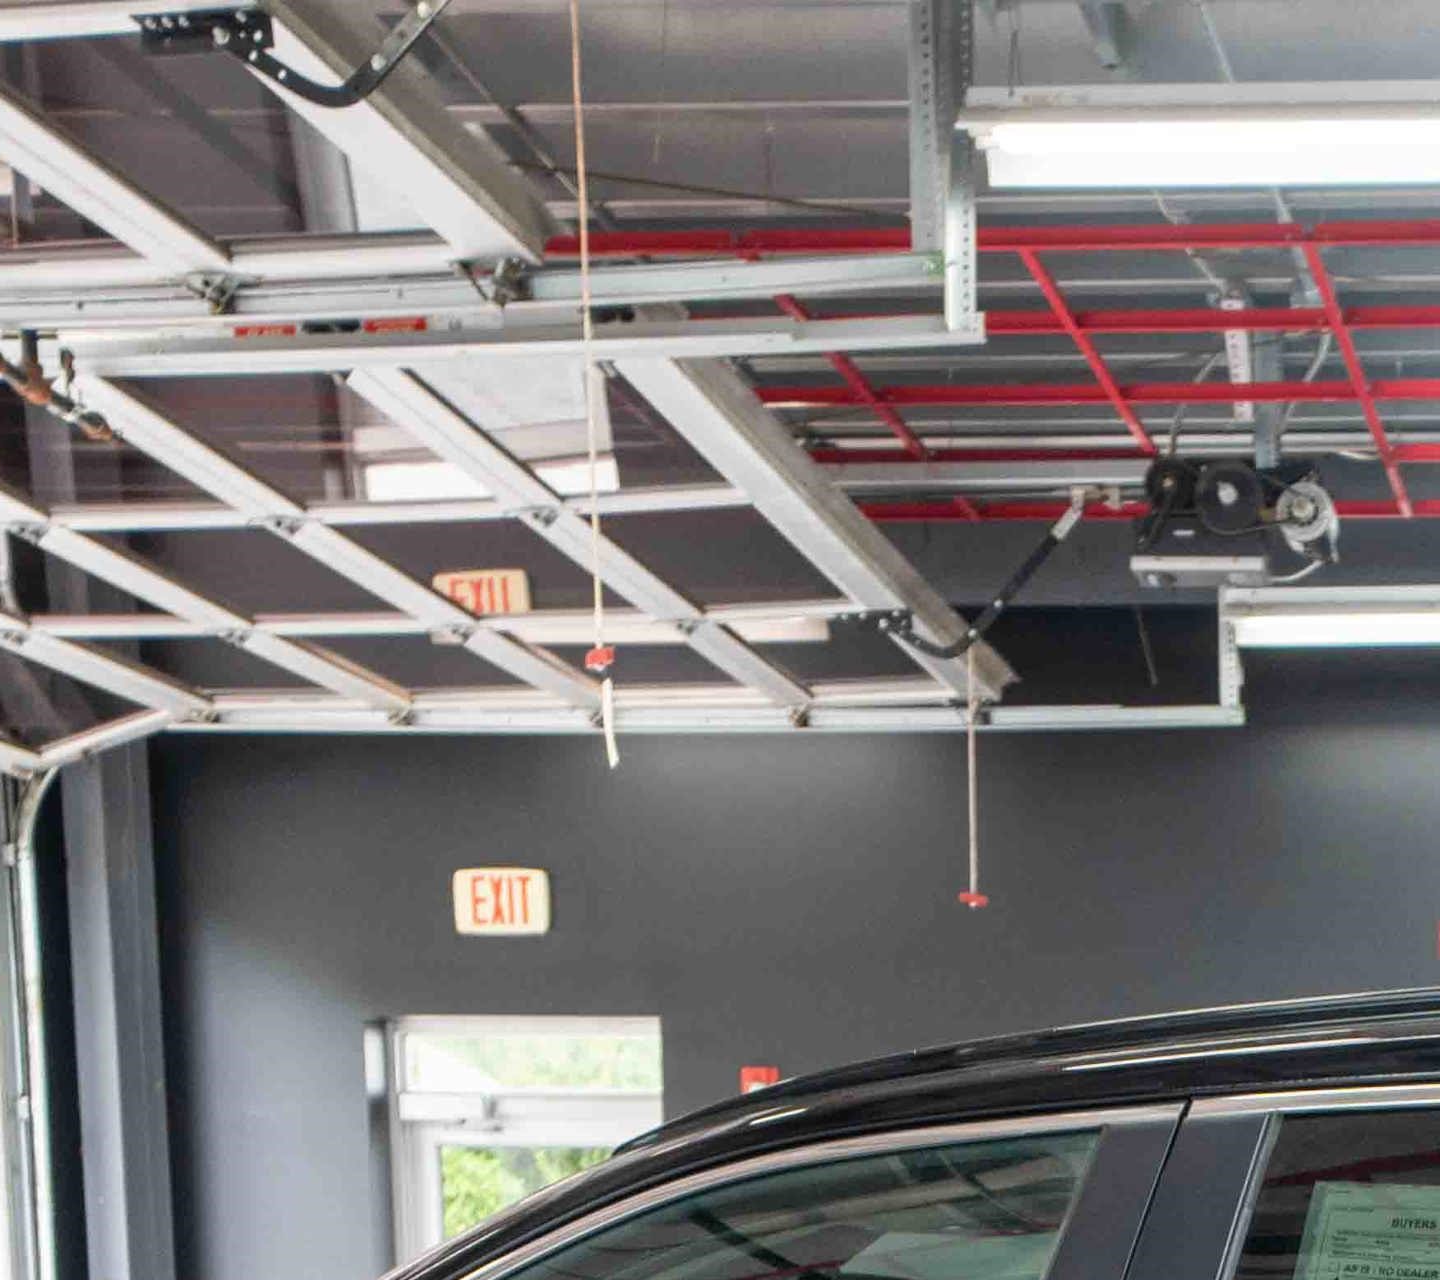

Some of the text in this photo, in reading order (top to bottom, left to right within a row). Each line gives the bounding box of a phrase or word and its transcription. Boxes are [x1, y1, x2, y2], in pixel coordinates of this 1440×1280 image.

[470, 875, 531, 925] EXIT
[1391, 1217, 1437, 1230] BUYERS
[1396, 1267, 1439, 1279] DEALER
